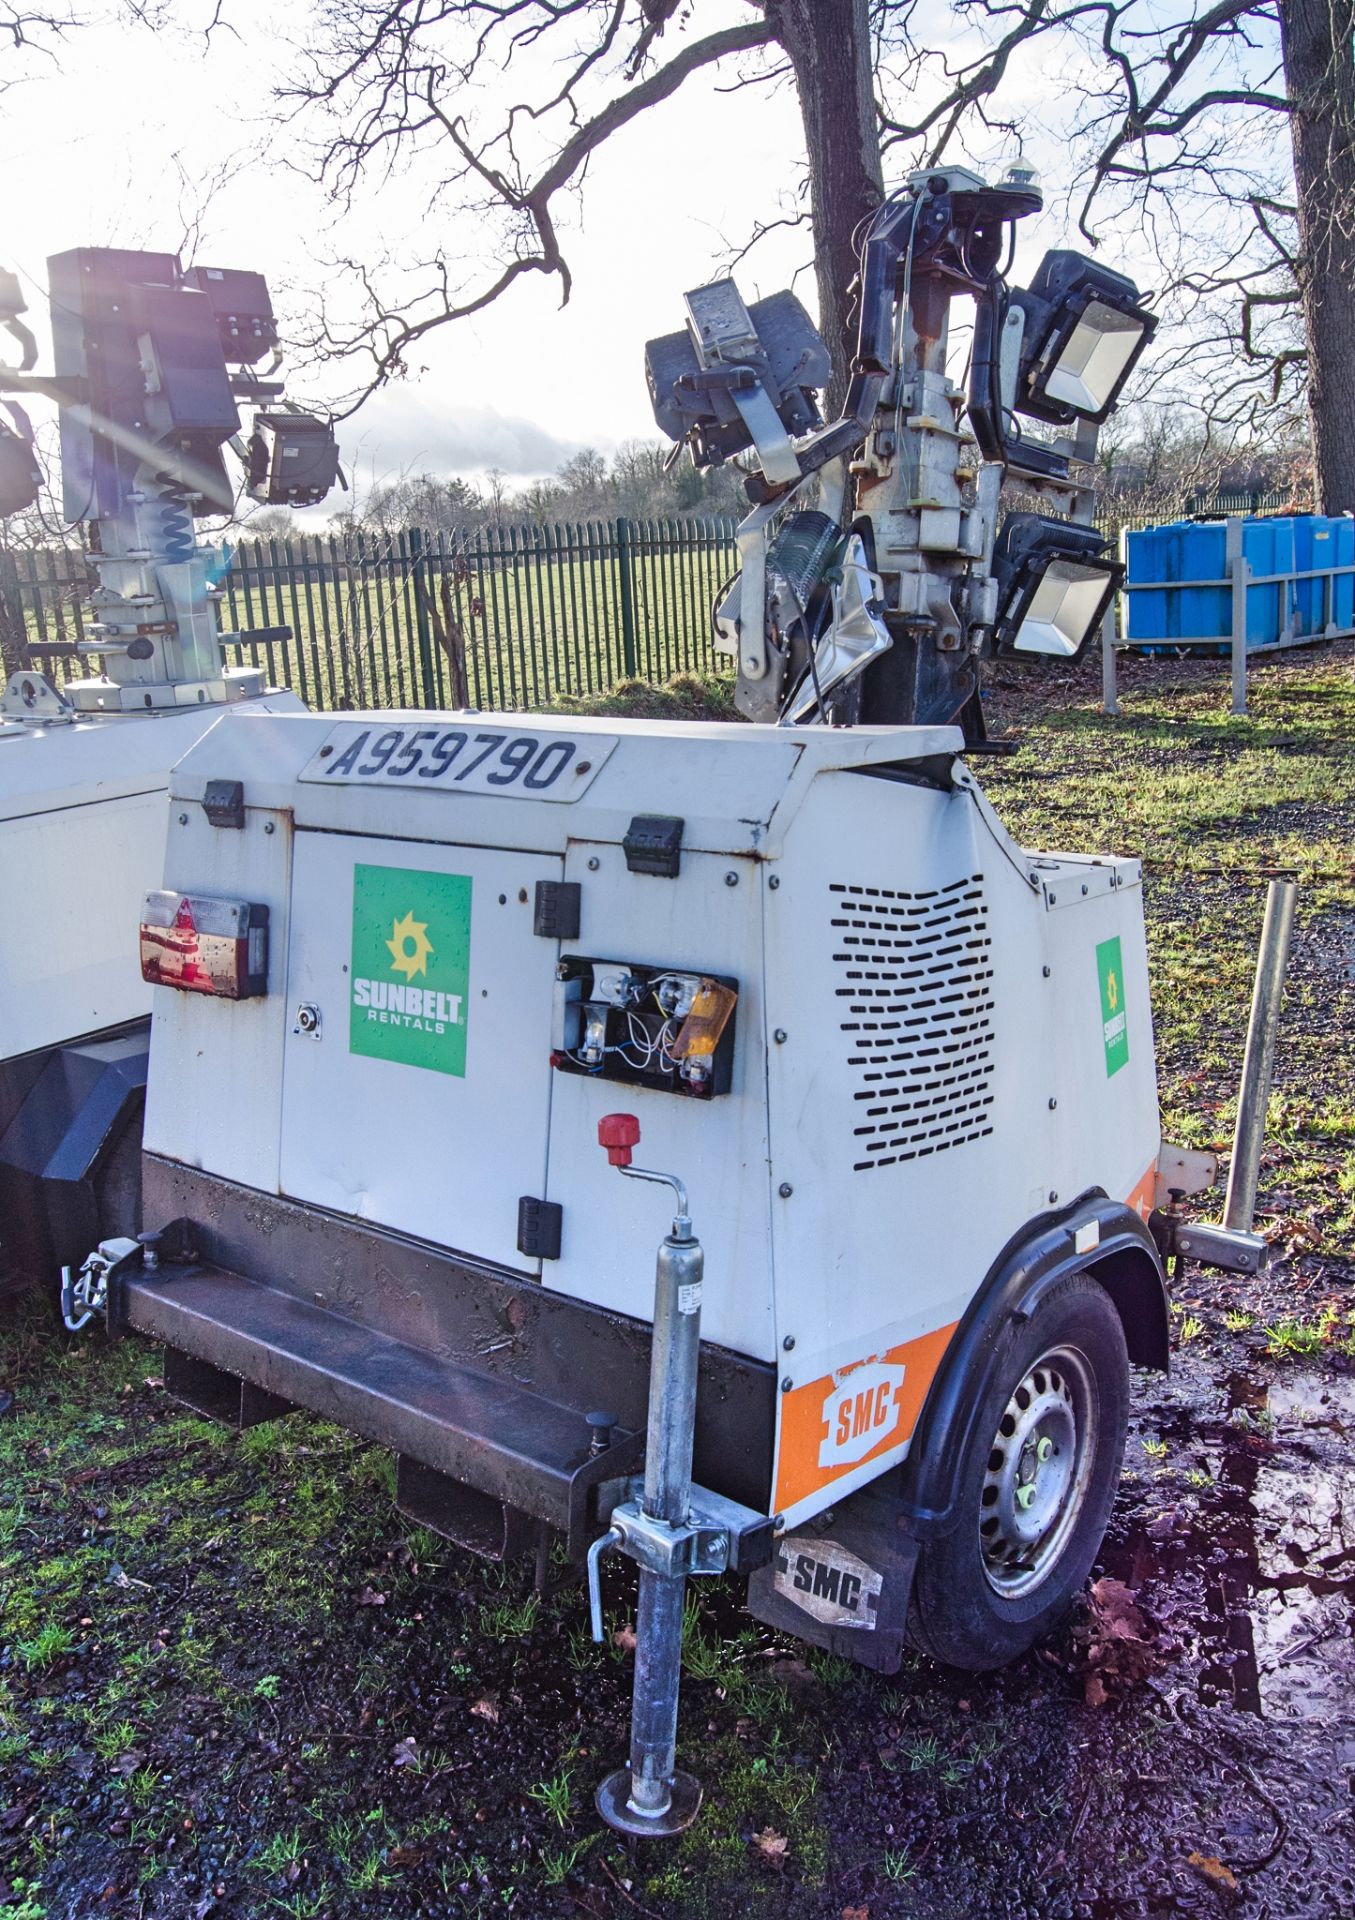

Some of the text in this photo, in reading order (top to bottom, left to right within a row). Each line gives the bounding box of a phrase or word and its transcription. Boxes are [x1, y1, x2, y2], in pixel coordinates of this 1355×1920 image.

[325, 731, 577, 790] A959790
[353, 977, 462, 1024] SUNBELT
[367, 1009, 445, 1034] RENTALS
[836, 1381, 891, 1447] SMC
[793, 1554, 862, 1612] SMC
